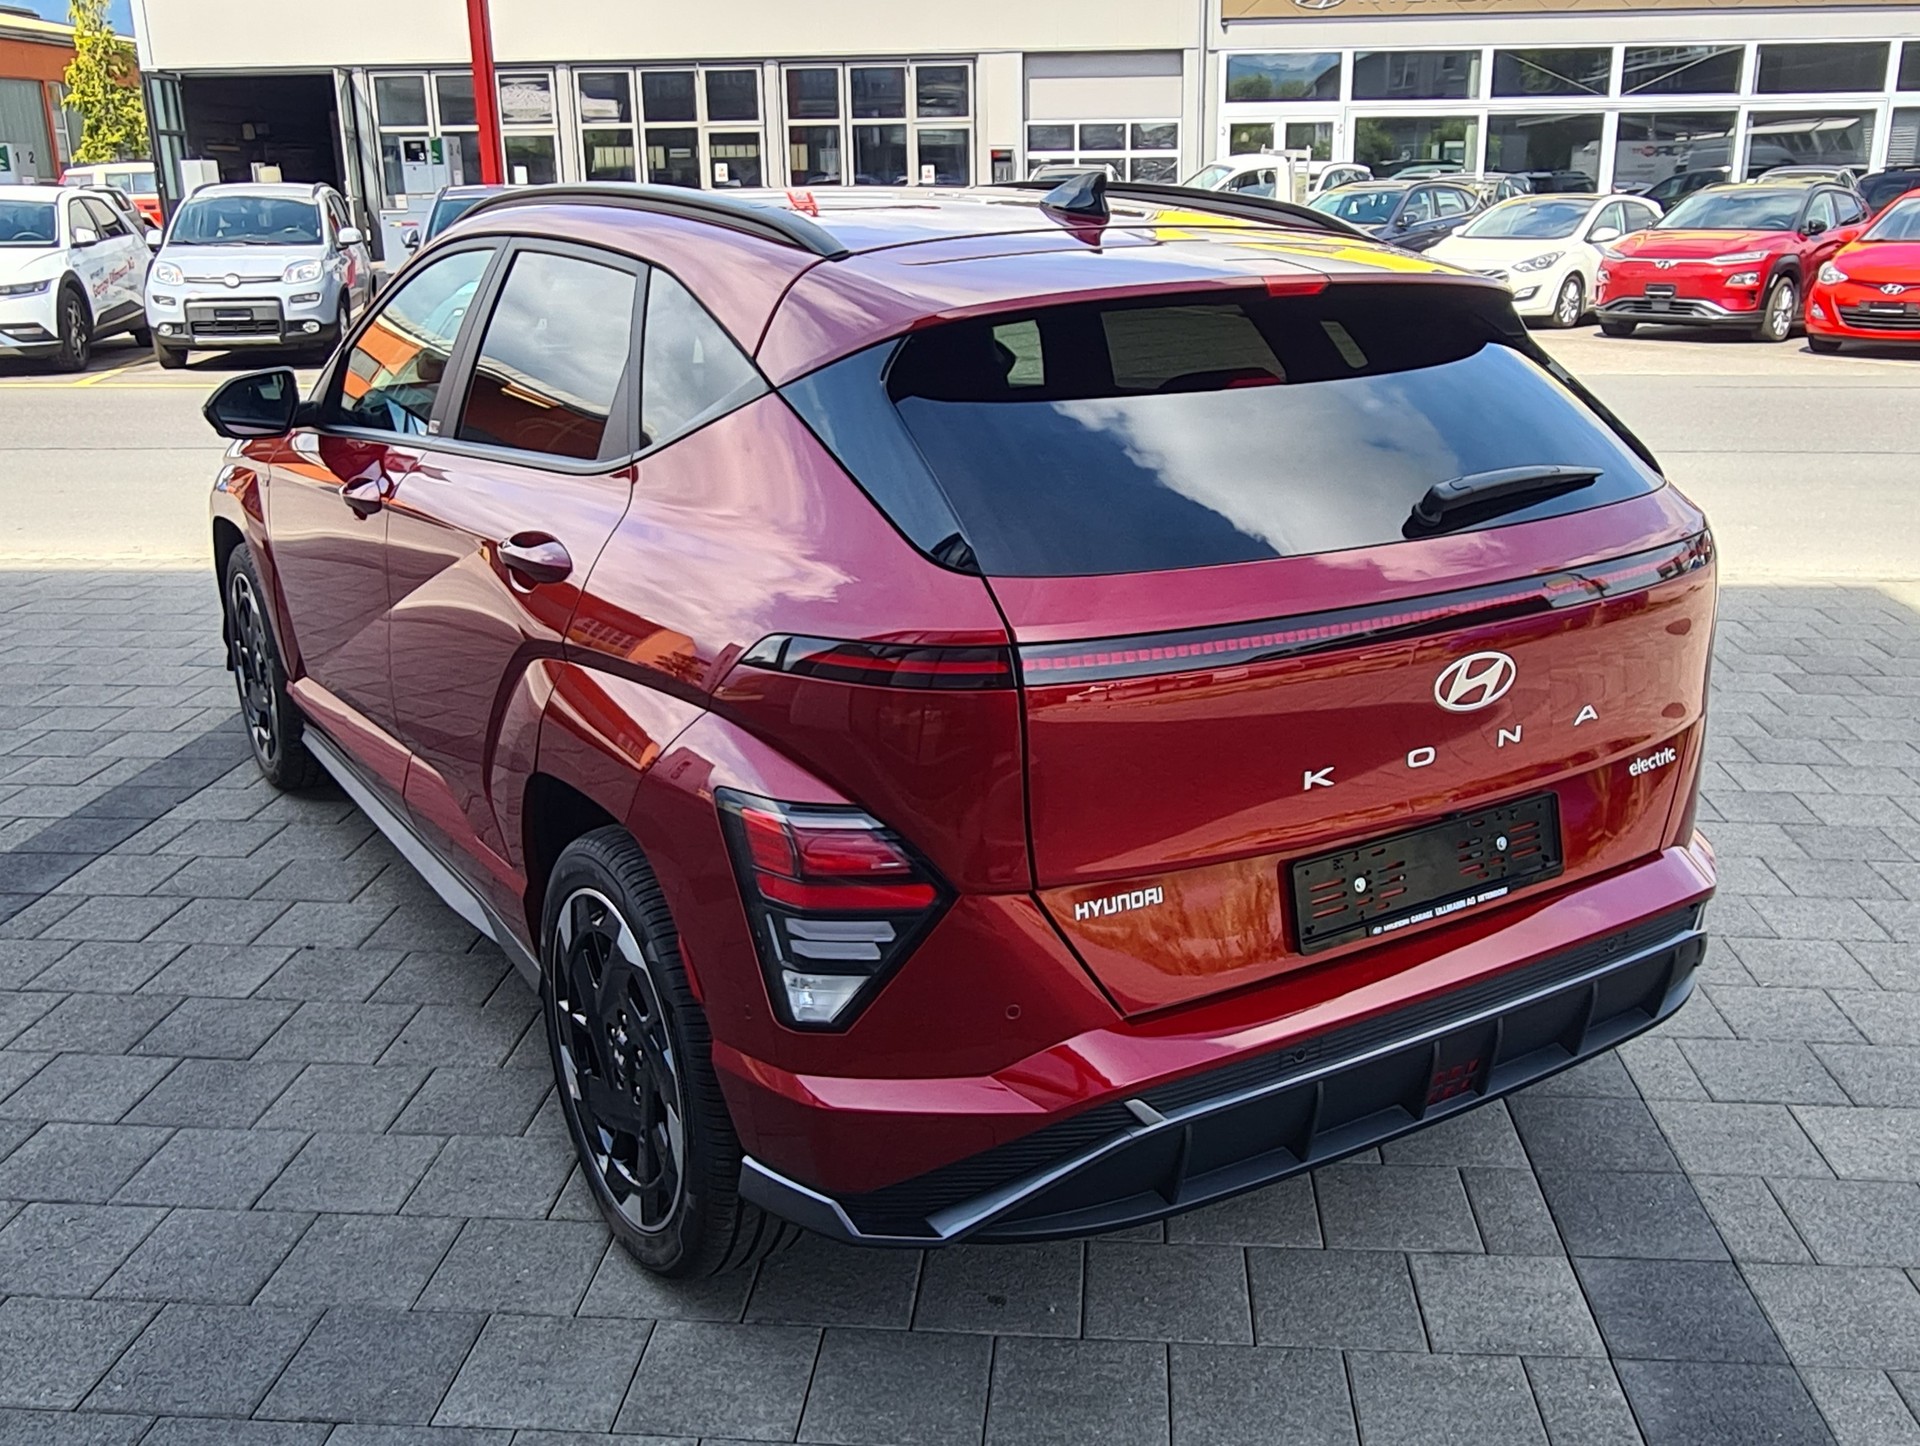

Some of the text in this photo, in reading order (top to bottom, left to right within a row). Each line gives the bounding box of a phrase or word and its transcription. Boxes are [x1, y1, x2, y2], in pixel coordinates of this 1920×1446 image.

[15, 151, 35, 164] 1 2
[1304, 704, 1598, 790] KONA
[1629, 747, 1676, 777] electric
[1074, 886, 1164, 921] HYUNDAI
[1466, 896, 1476, 906] AG
